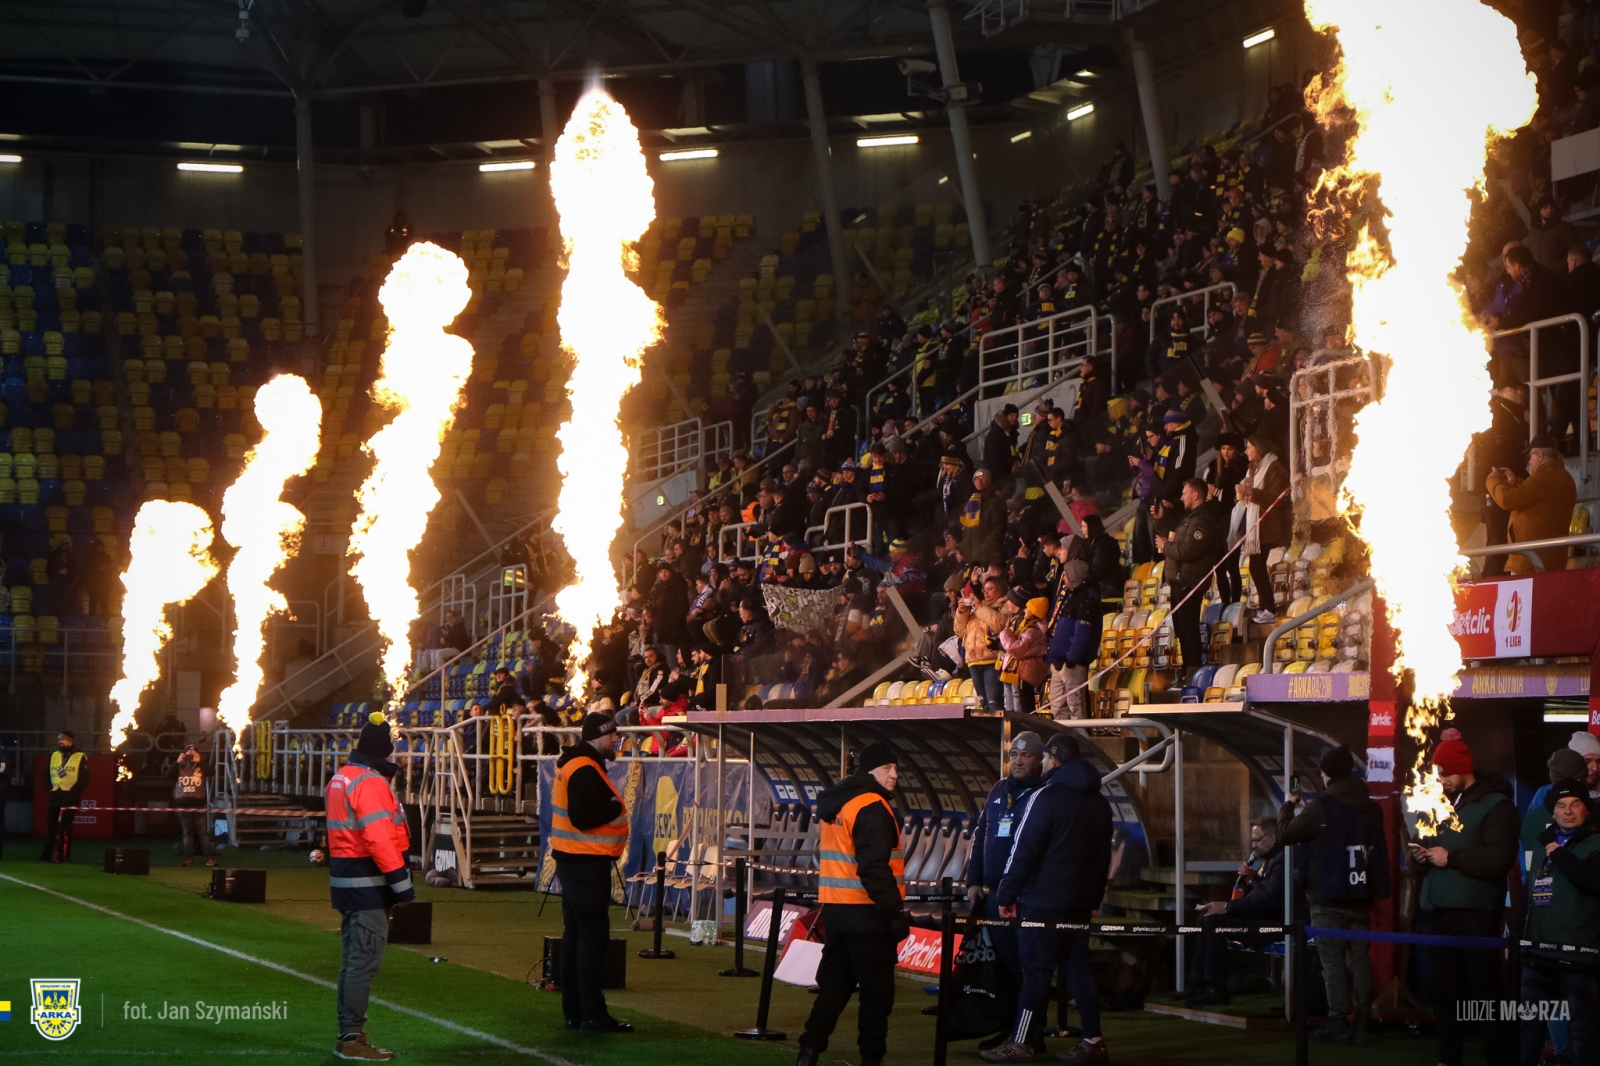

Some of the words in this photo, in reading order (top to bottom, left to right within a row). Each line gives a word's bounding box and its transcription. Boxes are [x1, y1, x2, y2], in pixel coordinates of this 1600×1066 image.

[1510, 636, 1521, 648] LIGA
[1472, 670, 1496, 694] ARKA
[179, 776, 201, 787] FOTO
[1349, 871, 1367, 885] 04
